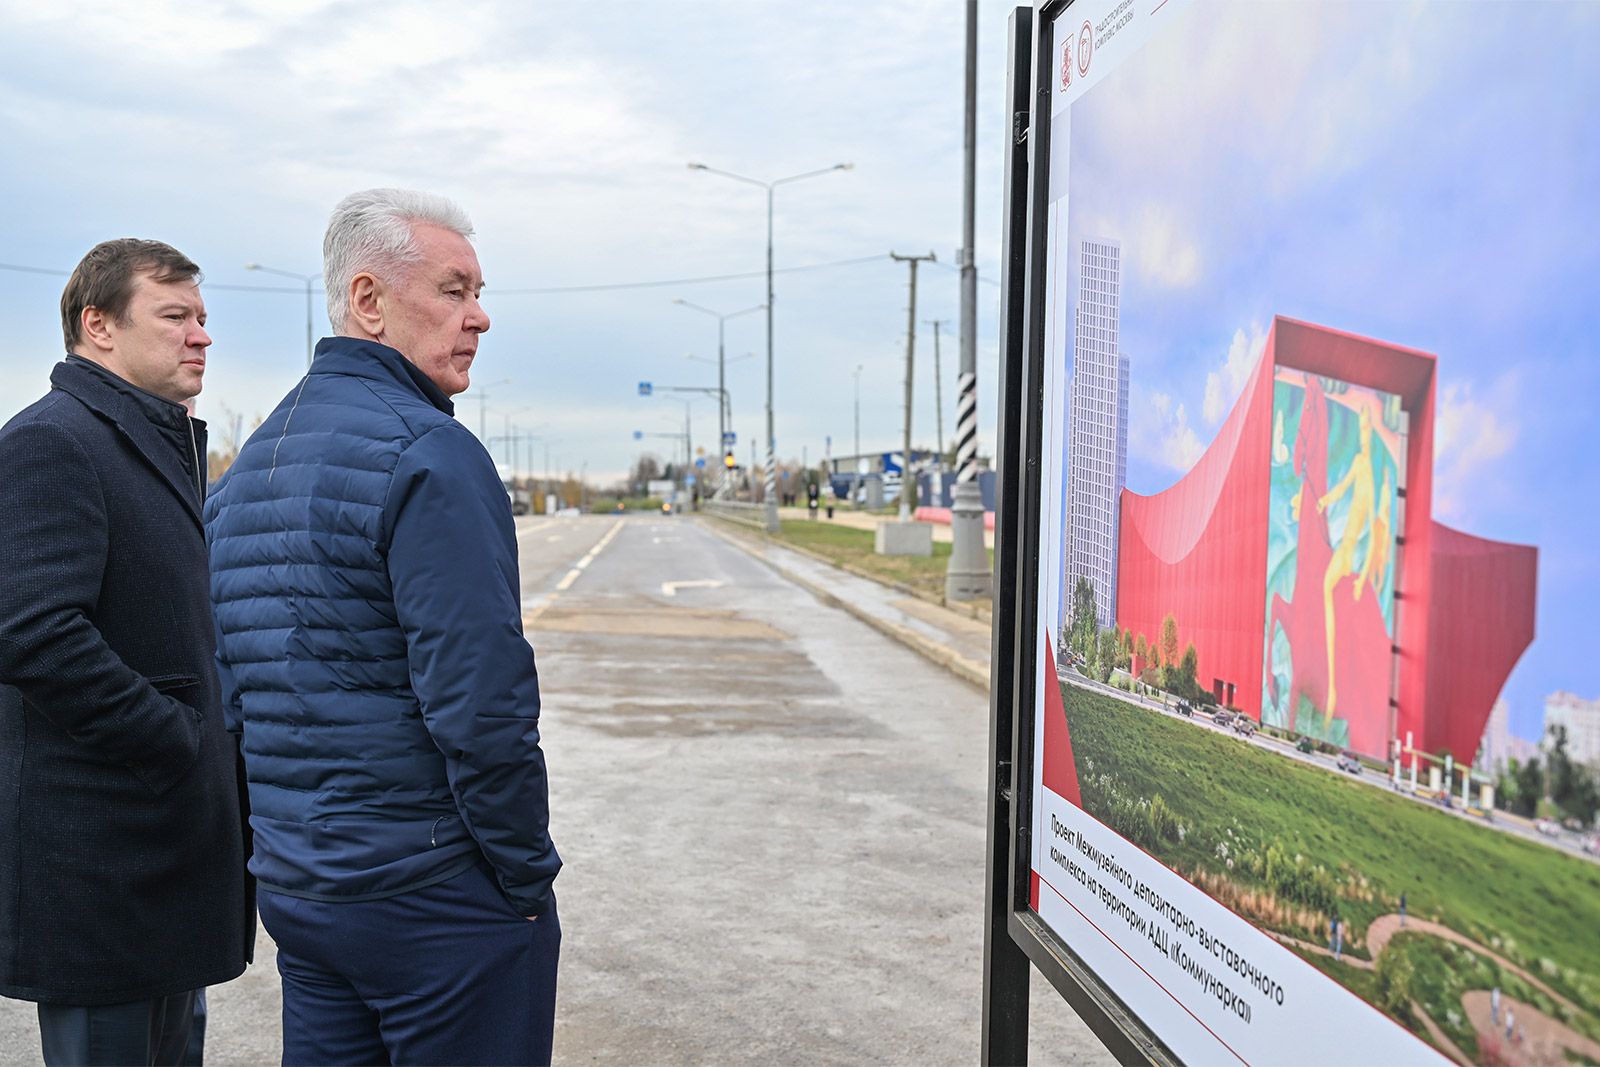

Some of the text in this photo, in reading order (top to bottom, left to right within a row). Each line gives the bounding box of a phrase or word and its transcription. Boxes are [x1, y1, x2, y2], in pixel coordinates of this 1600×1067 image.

[1050, 846, 1251, 1024] комплекса на территории АДЦ «Коммунарка»
[1051, 813, 1284, 1006] Проект Межмузейного депозитарно-выставочного
